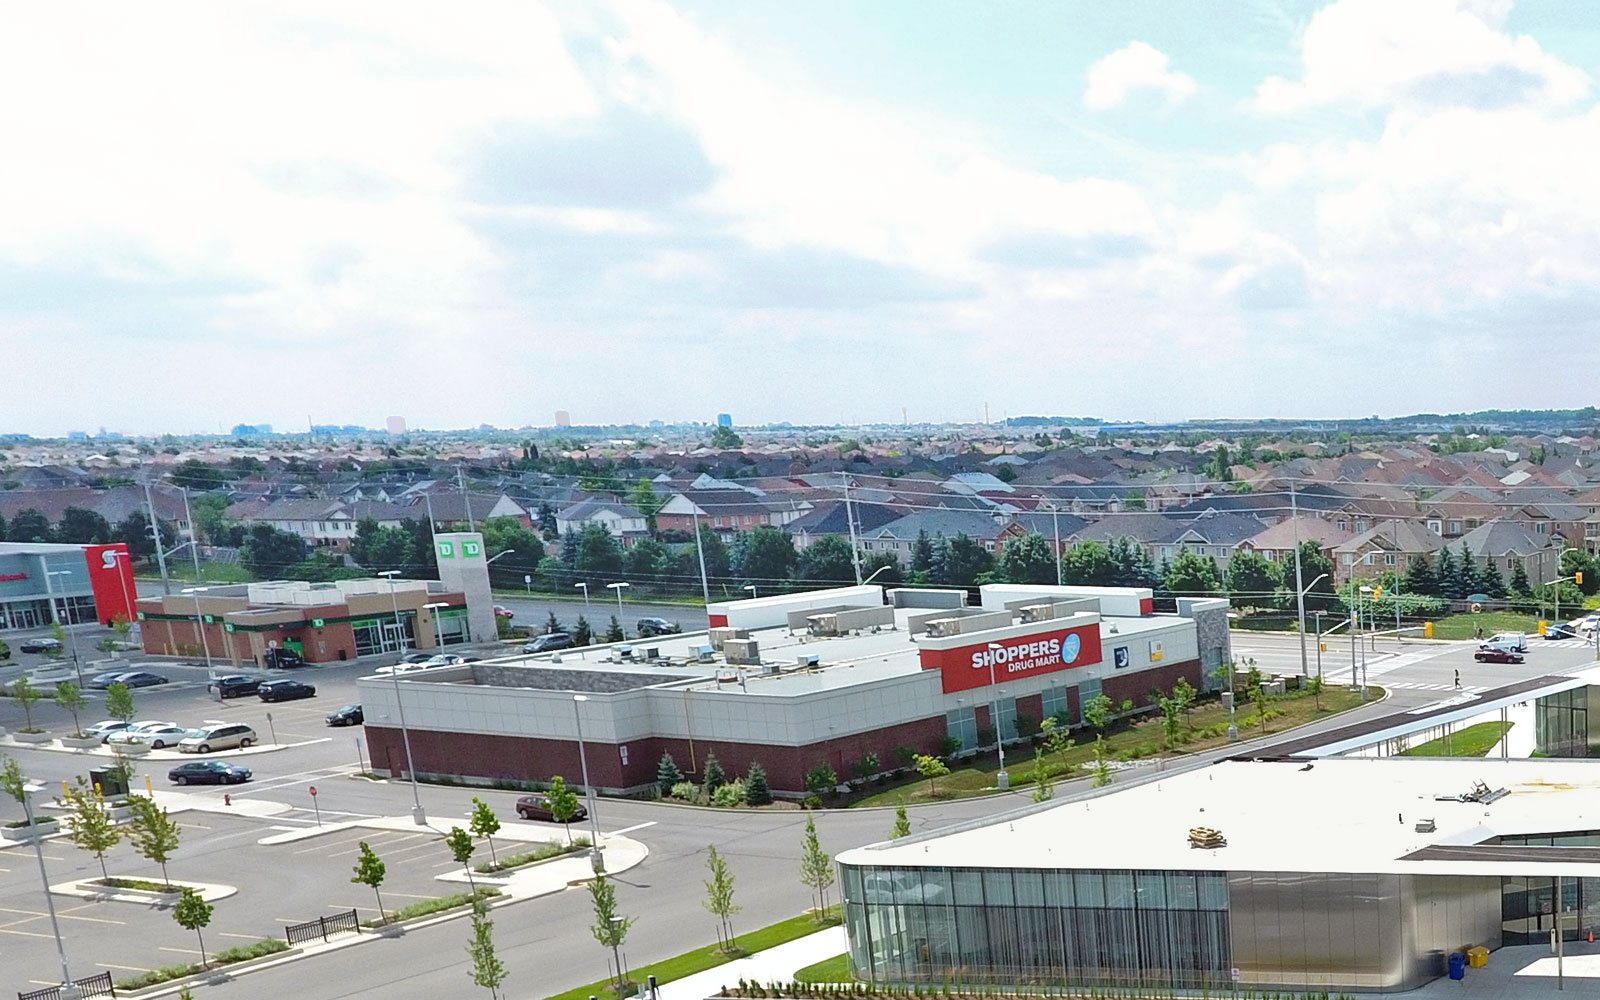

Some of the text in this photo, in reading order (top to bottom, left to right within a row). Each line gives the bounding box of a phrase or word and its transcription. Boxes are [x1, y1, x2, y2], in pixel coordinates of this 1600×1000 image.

[972, 638, 1060, 668] SHOPPERS
[1008, 654, 1060, 672] DRUG MART
